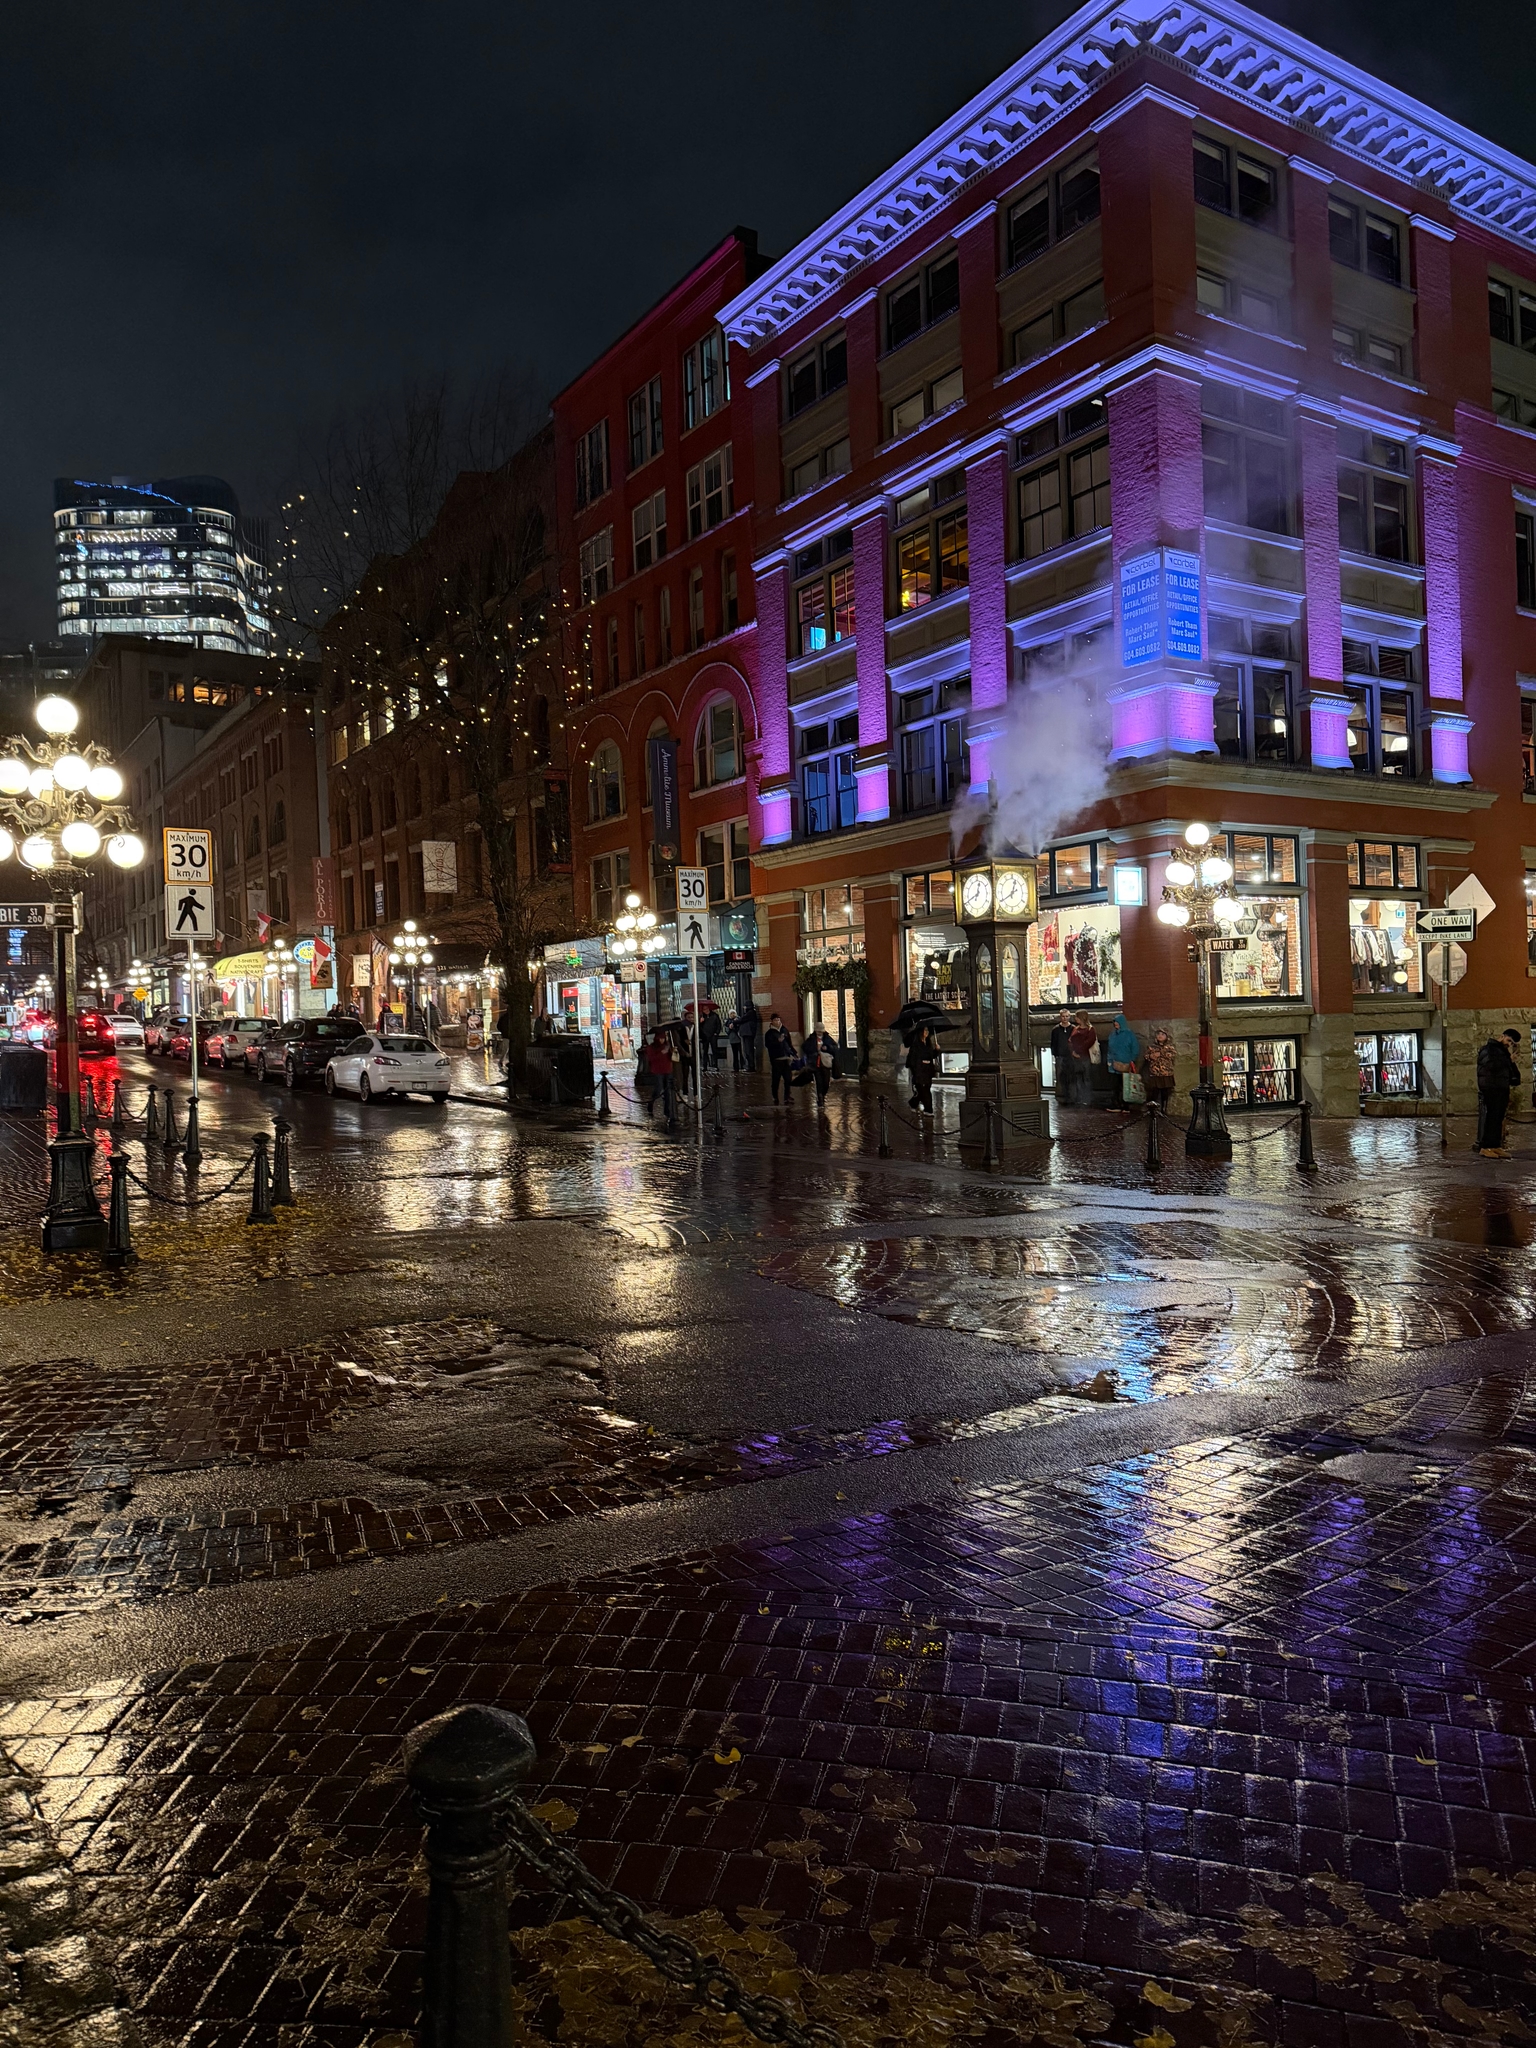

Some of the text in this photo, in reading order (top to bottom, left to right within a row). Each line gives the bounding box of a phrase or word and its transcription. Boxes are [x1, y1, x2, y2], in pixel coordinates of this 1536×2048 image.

[1129, 557, 1156, 574] corbel
[1173, 558, 1197, 570] corbel
[1122, 574, 1160, 598] FOR LEASE
[1165, 572, 1199, 590] FOR LEASE
[1124, 591, 1159, 610] RETAIL/OFFICE
[1167, 590, 1198, 604] RETAIL/OFFICE
[1123, 602, 1160, 621] OPPORTUNITIES
[1166, 600, 1199, 614] OPPORTUNITIES
[1125, 620, 1159, 637] Robert Tham
[1167, 616, 1198, 630] Robert Tham
[1171, 626, 1184, 637] Marc
[1128, 633, 1142, 645] Marc
[664, 791, 673, 830] Museum
[170, 834, 206, 843] MAXIMUM
[171, 843, 207, 868] 30
[176, 869, 202, 878] km/h
[680, 870, 705, 878] MAXIMUM
[681, 879, 705, 898] 30
[316, 878, 326, 919] PORTO
[684, 899, 702, 907] km/h
[0, 907, 38, 923] BIE ST
[27, 915, 43, 923] 200
[1430, 916, 1469, 926] ONE WAY
[1212, 940, 1234, 950] WATER
[925, 992, 934, 1000] THE
